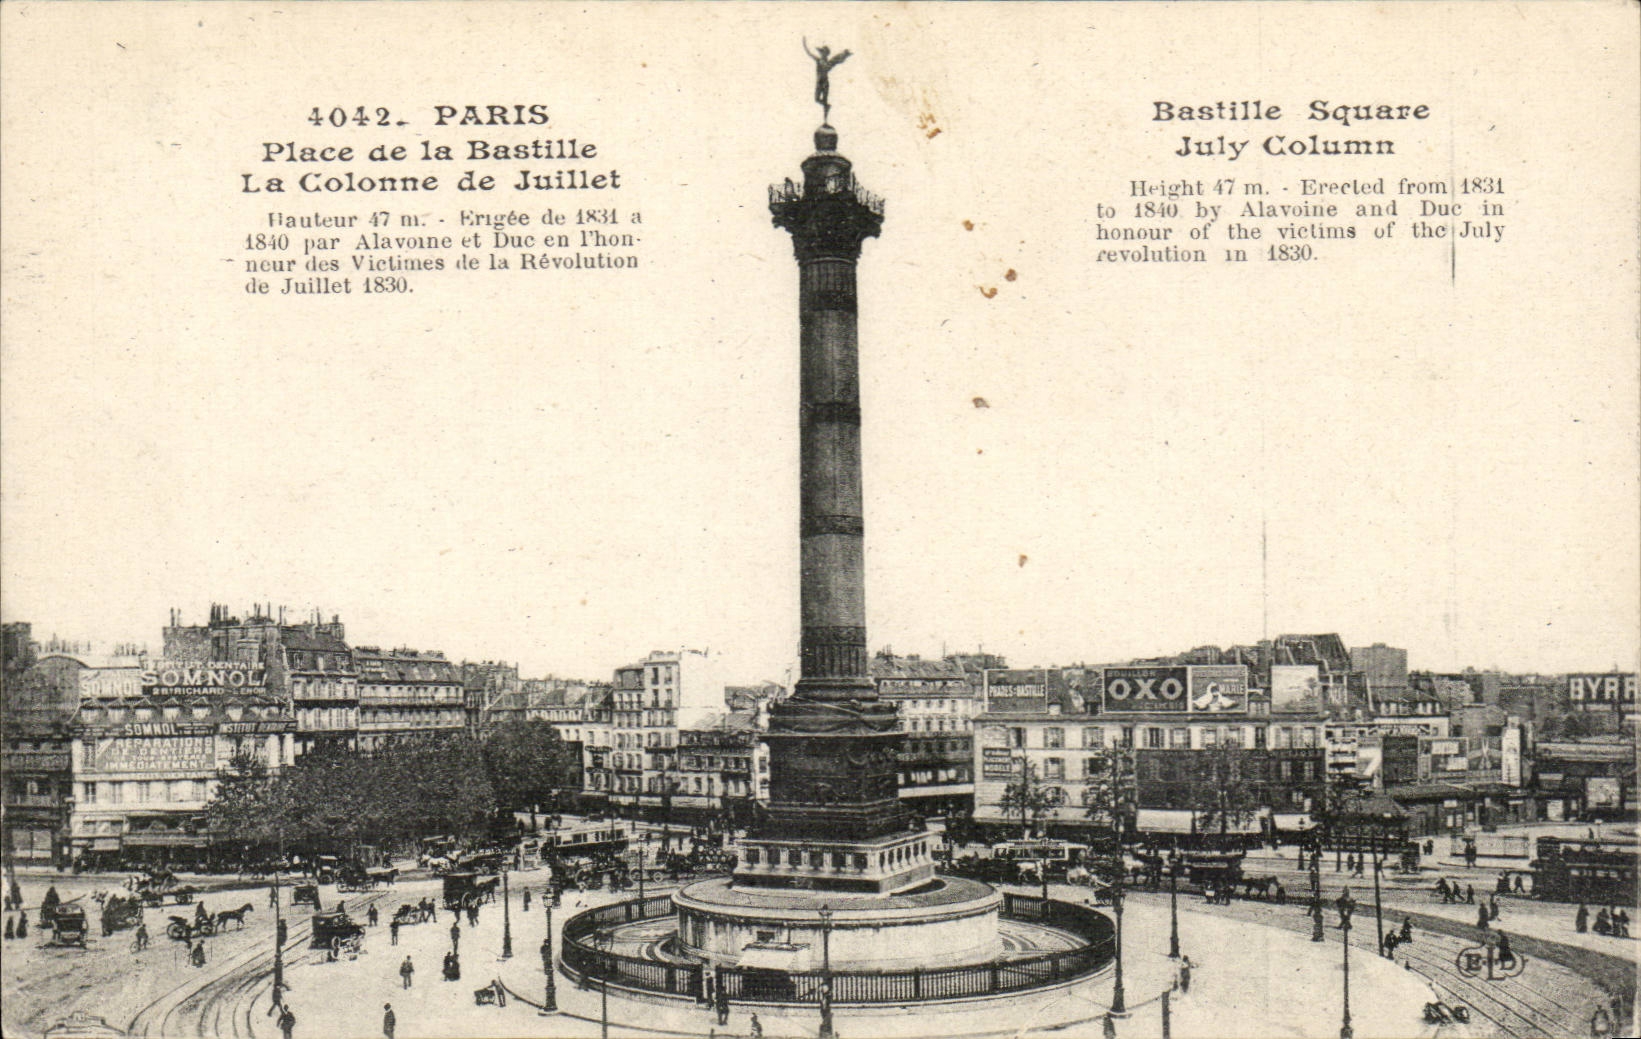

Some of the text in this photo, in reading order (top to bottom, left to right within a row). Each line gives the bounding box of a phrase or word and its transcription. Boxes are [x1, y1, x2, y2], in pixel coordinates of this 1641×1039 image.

[141, 669, 261, 687] SOMNOL
[1107, 678, 1184, 700] OXO
[125, 723, 178, 736] SOMNOL
